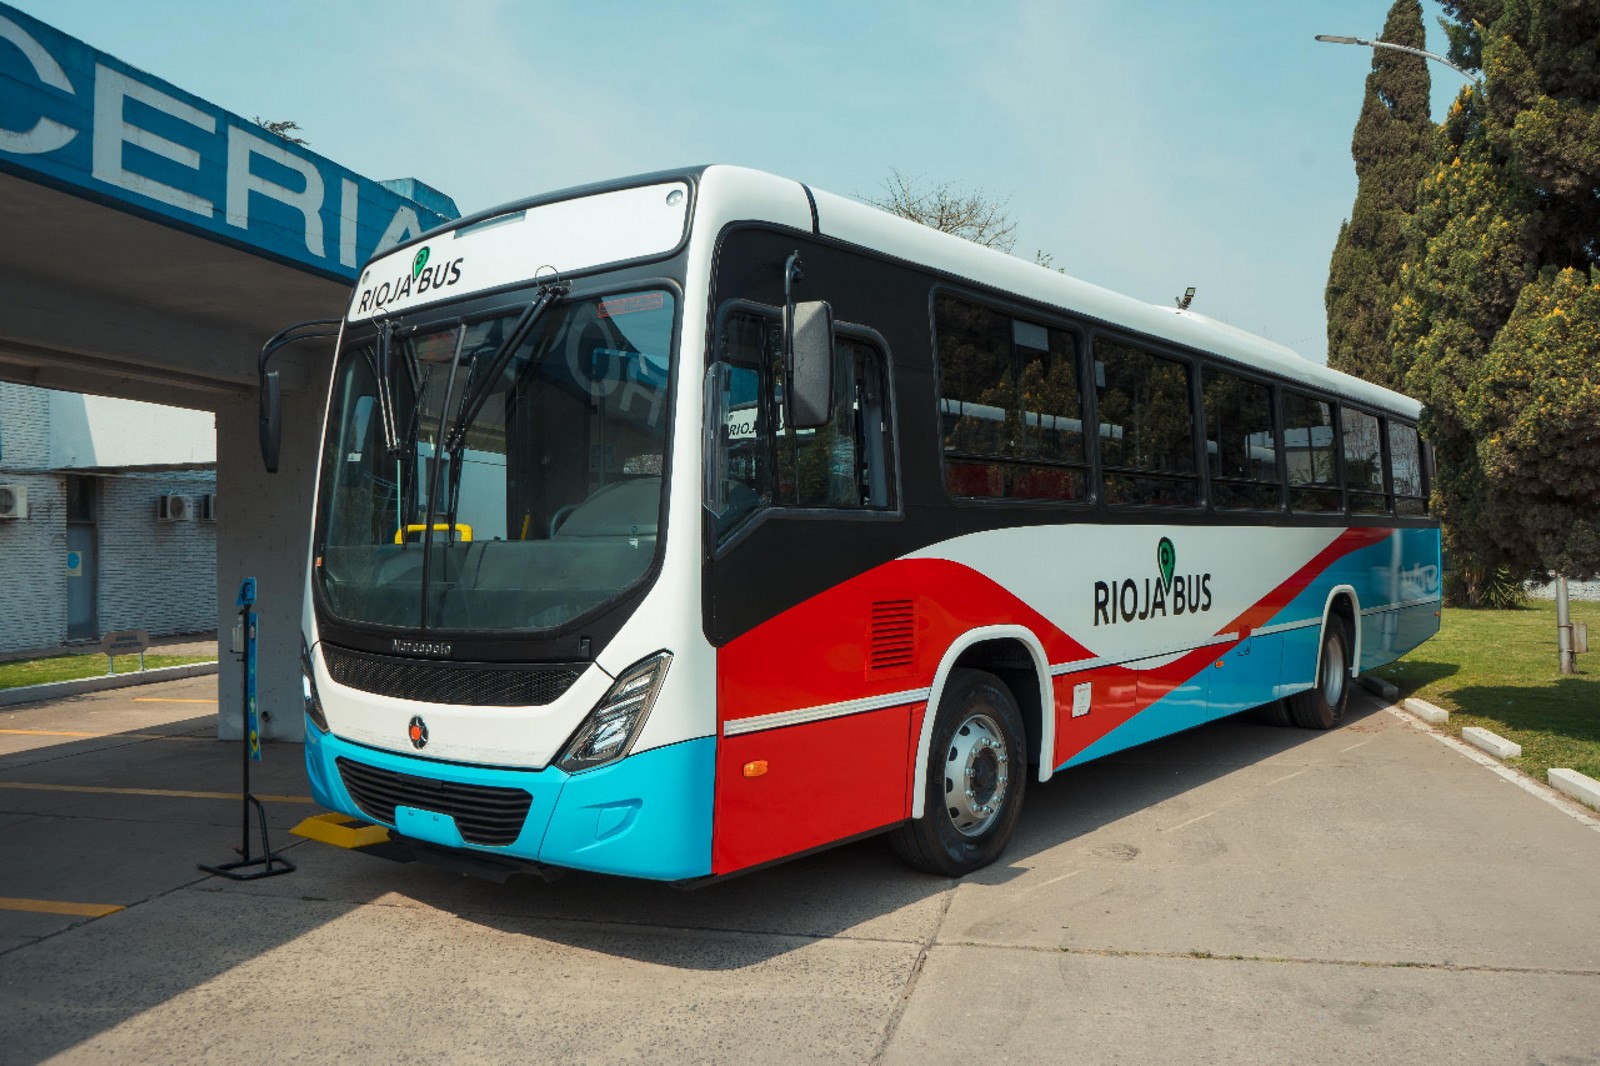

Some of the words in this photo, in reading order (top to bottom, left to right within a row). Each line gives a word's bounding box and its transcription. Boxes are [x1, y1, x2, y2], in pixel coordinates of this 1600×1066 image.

[357, 274, 411, 314] RIOJA
[417, 257, 464, 294] BUS
[1094, 577, 1166, 626] RIOJA
[1173, 573, 1211, 615] BUS
